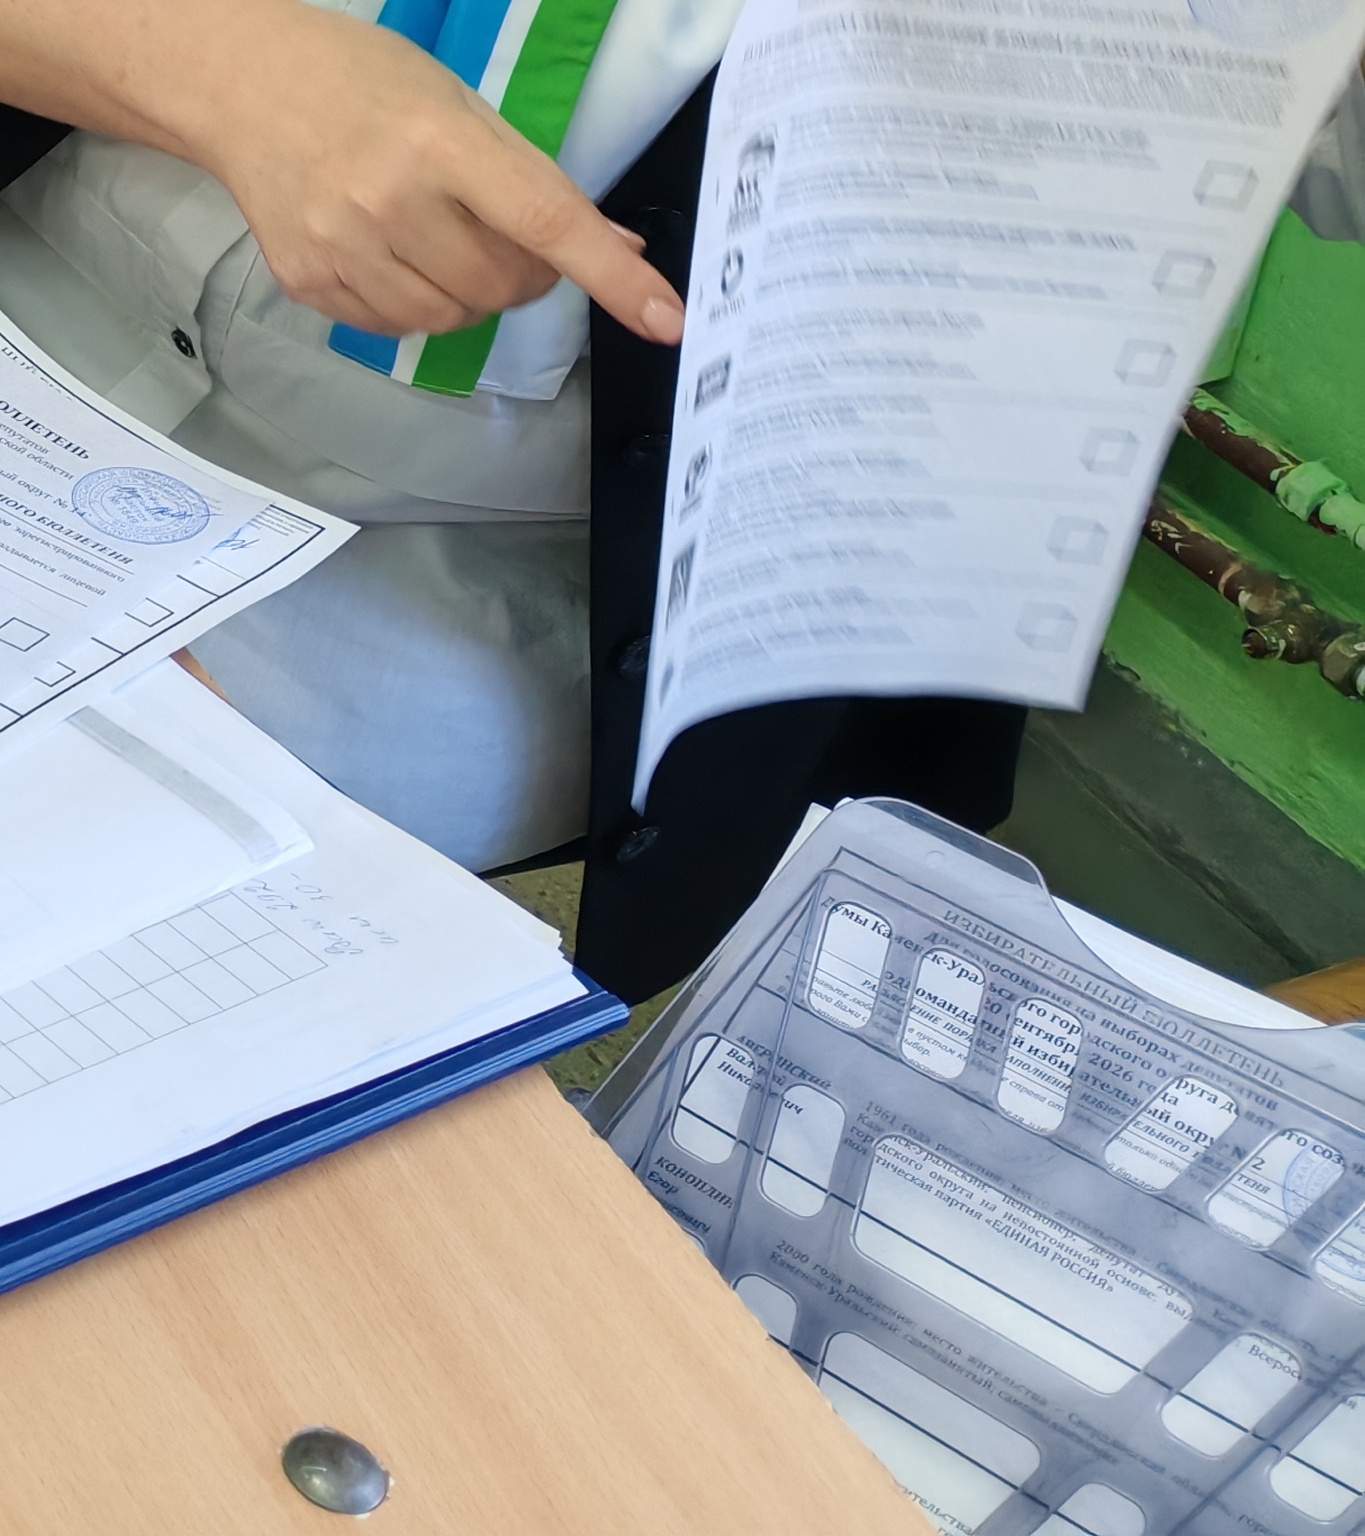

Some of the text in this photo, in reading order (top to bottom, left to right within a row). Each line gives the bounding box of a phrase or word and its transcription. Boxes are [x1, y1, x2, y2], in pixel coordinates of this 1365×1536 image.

[26, 452, 74, 480] области
[17, 479, 53, 499] округ
[52, 497, 76, 509] №
[35, 515, 133, 564] БЮЛЛЕТЕНЯ
[1003, 1011, 1082, 1059] ентябр
[1087, 1051, 1135, 1083] 2026
[1098, 1016, 1180, 1064] выборах
[716, 1059, 803, 1115] Никоеич
[999, 1049, 1074, 1095] АПОЛНЕНИ
[1153, 1064, 1222, 1107] оруга
[1025, 1040, 1171, 1123] избиательый
[1172, 1118, 1223, 1152] окру
[1251, 1156, 1265, 1171] 2
[847, 1124, 924, 1172] гордского
[842, 1136, 934, 1192] полтическая
[982, 1214, 1050, 1260] «ЕДИНАЯ
[1048, 1250, 1117, 1294] РОССИЯ»
